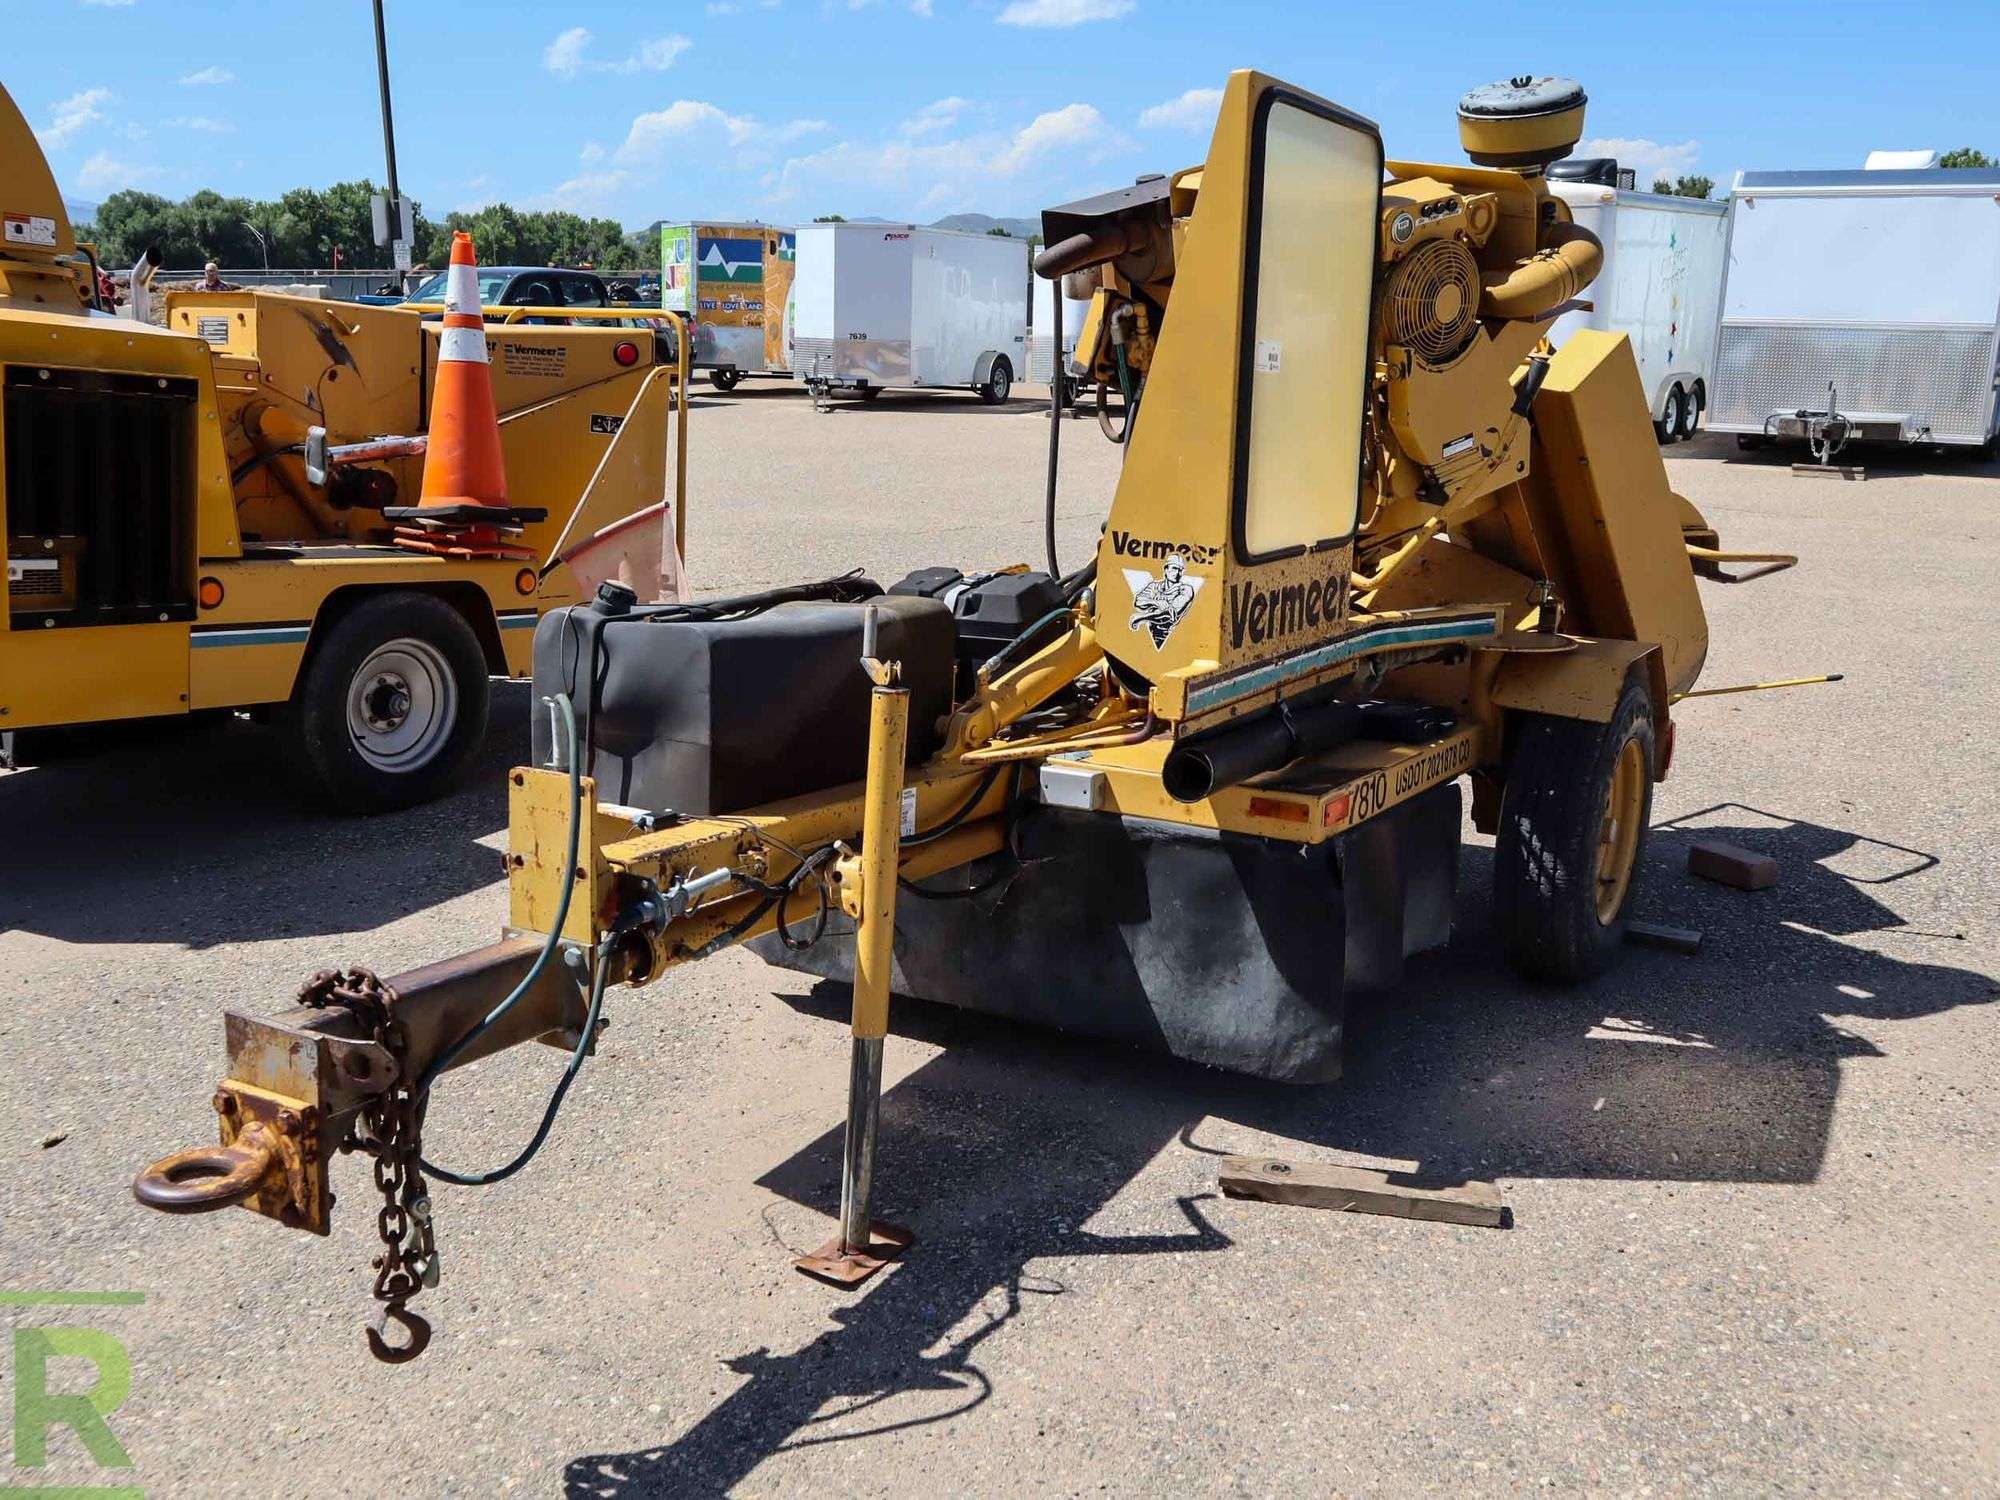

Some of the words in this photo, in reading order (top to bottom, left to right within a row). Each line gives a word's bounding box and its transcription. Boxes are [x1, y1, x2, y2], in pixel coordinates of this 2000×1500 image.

[513, 344, 557, 355] Vermeer
[1230, 574, 1349, 649] Vermeer
[1396, 759, 1426, 796] USDOT
[1459, 738, 1470, 764] CO
